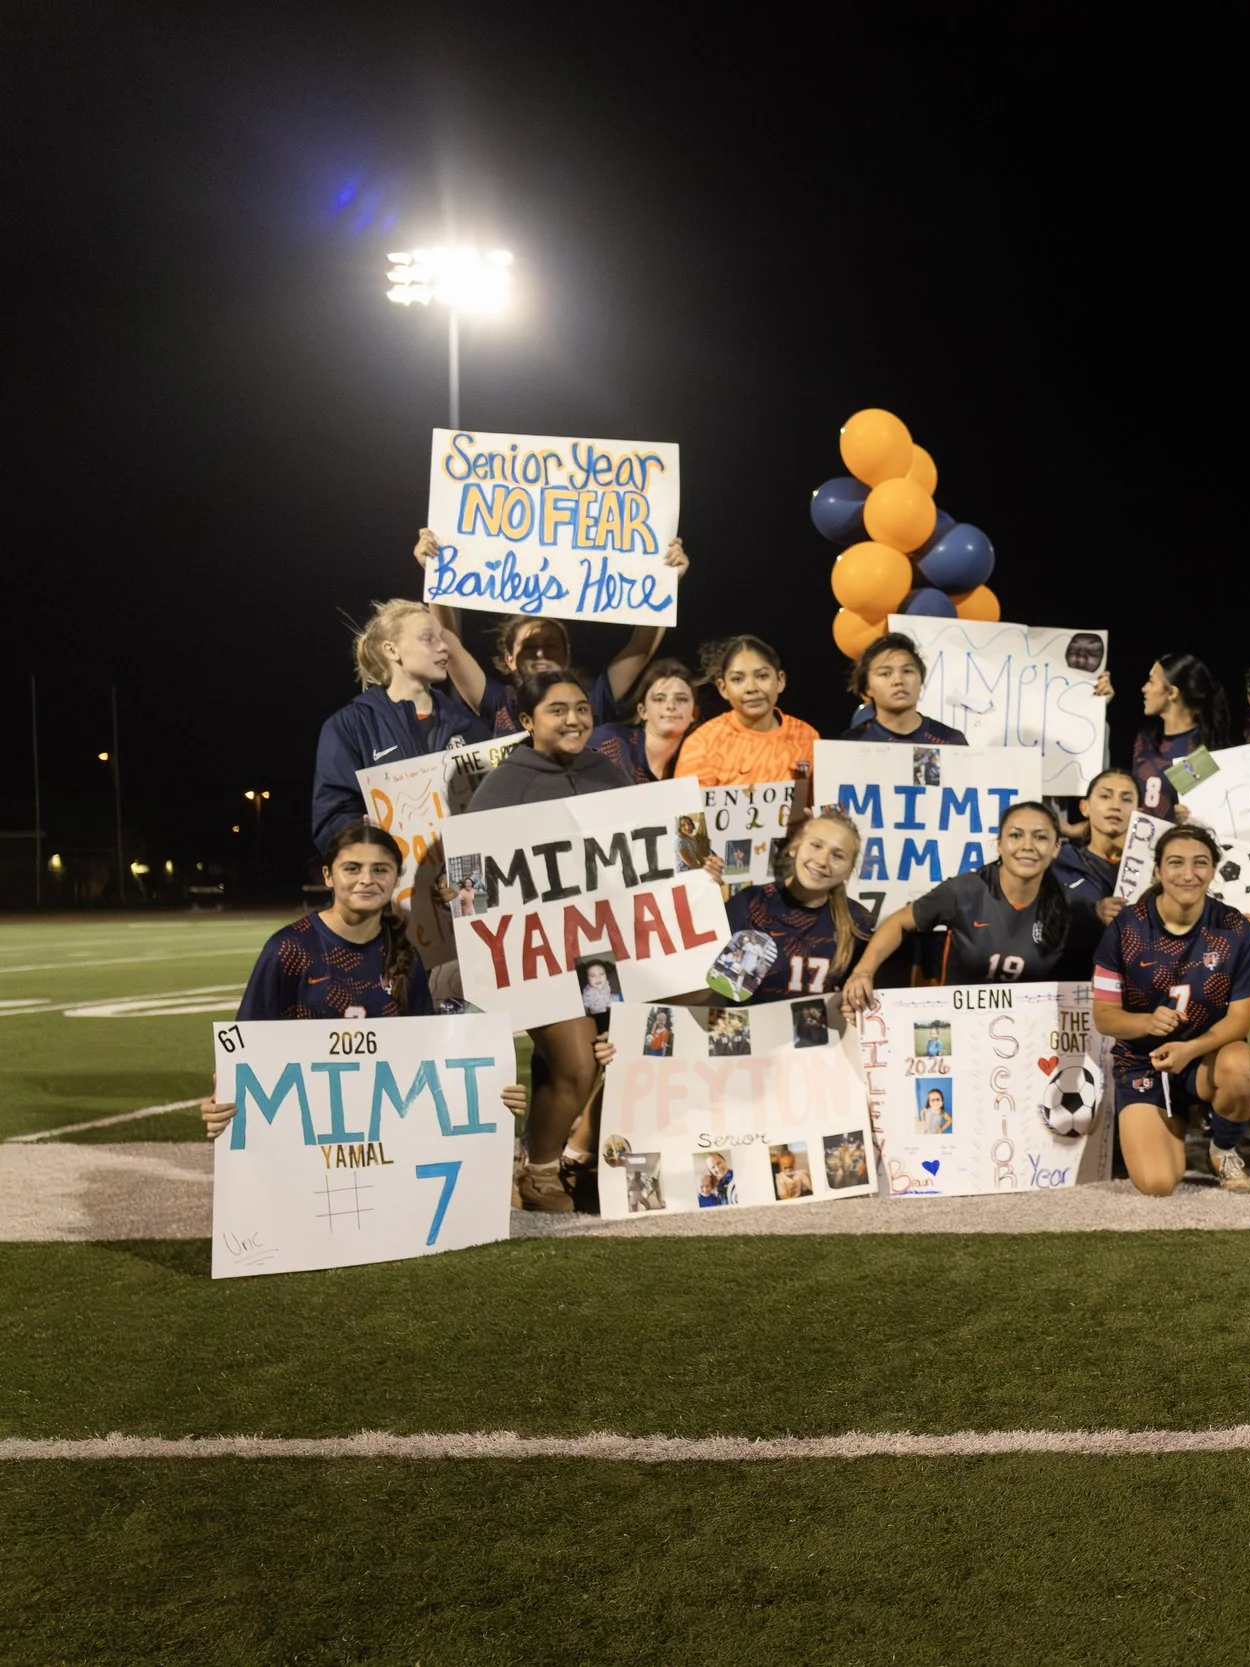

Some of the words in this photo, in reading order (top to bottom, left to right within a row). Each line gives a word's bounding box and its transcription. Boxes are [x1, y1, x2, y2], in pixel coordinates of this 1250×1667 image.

[444, 433, 563, 483] Senior
[568, 442, 665, 490] Year
[457, 482, 535, 542] NO
[539, 484, 659, 554] FEAR
[428, 545, 569, 613] Bailey's
[576, 556, 673, 613] Here
[451, 751, 485, 776] THE
[704, 786, 796, 807] ENIOR
[838, 784, 1019, 833] MIMI
[1144, 776, 1162, 808] 8
[715, 804, 792, 832] 026
[484, 826, 674, 908] MIMI
[858, 837, 986, 882] AMA
[470, 884, 718, 990] YAMAL
[789, 956, 831, 993] 17
[989, 953, 1025, 982] 19
[953, 989, 1013, 1010] GLENN
[1169, 984, 1191, 1019] 7
[1060, 1011, 1090, 1032] THE
[218, 1024, 245, 1053] 67
[329, 1031, 378, 1055] 2026
[1050, 1031, 1088, 1054] GOAT
[905, 1057, 950, 1077] 2026
[230, 1057, 497, 1150] MIMI
[620, 1050, 852, 1137] PEYTON
[321, 1142, 394, 1169] YAMAL
[697, 1132, 772, 1149] Senior
[1028, 1153, 1071, 1188] Year
